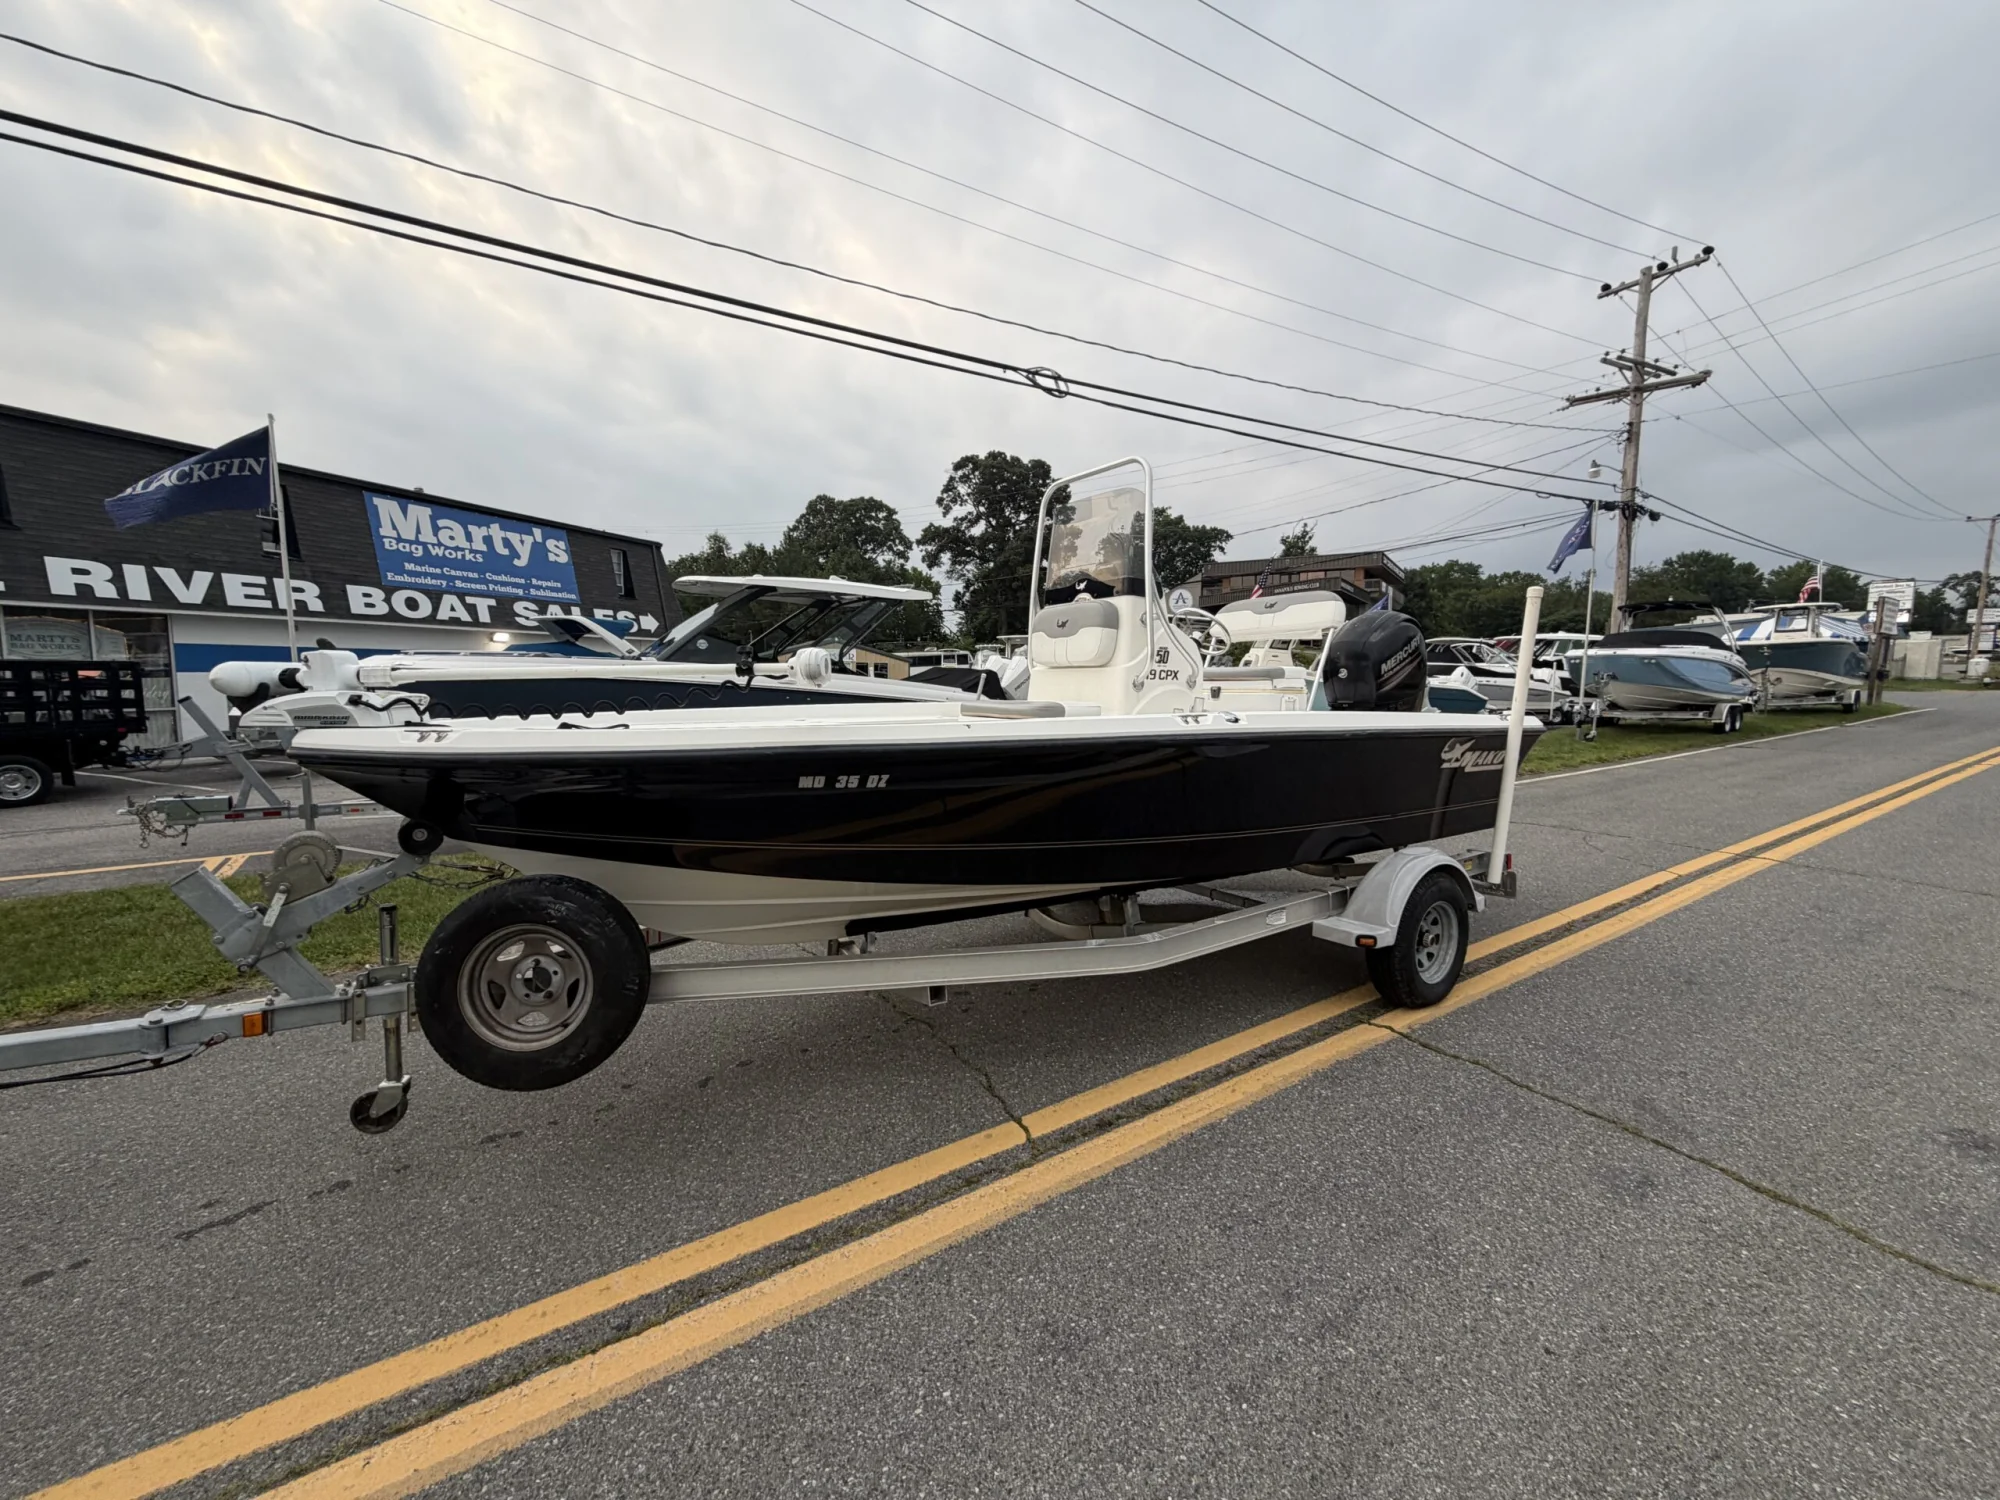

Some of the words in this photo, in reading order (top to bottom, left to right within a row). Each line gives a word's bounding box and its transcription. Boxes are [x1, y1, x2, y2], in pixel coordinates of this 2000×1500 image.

[119, 457, 267, 497] LACKFIN
[373, 496, 569, 567] Marty's
[382, 537, 423, 557] Bag
[427, 543, 484, 562] Works
[386, 572, 447, 588] Embroidery
[455, 580, 487, 590] Screen
[488, 584, 523, 595] Printing
[529, 588, 576, 599] Sublimation
[404, 562, 441, 574] Marine
[443, 567, 479, 578] Canvas
[486, 572, 525, 584] Cushions
[531, 578, 561, 588] Repairs
[43, 555, 326, 612] RIVER
[345, 584, 497, 624] BOAT
[1155, 649, 1170, 664] 50
[1380, 632, 1421, 675] MERCURY
[1146, 669, 1157, 680] 9
[1158, 669, 1179, 680] CPX
[1461, 750, 1506, 772] MAKO
[798, 776, 826, 788] MD
[835, 775, 860, 788] 35
[866, 774, 890, 788] DZ
